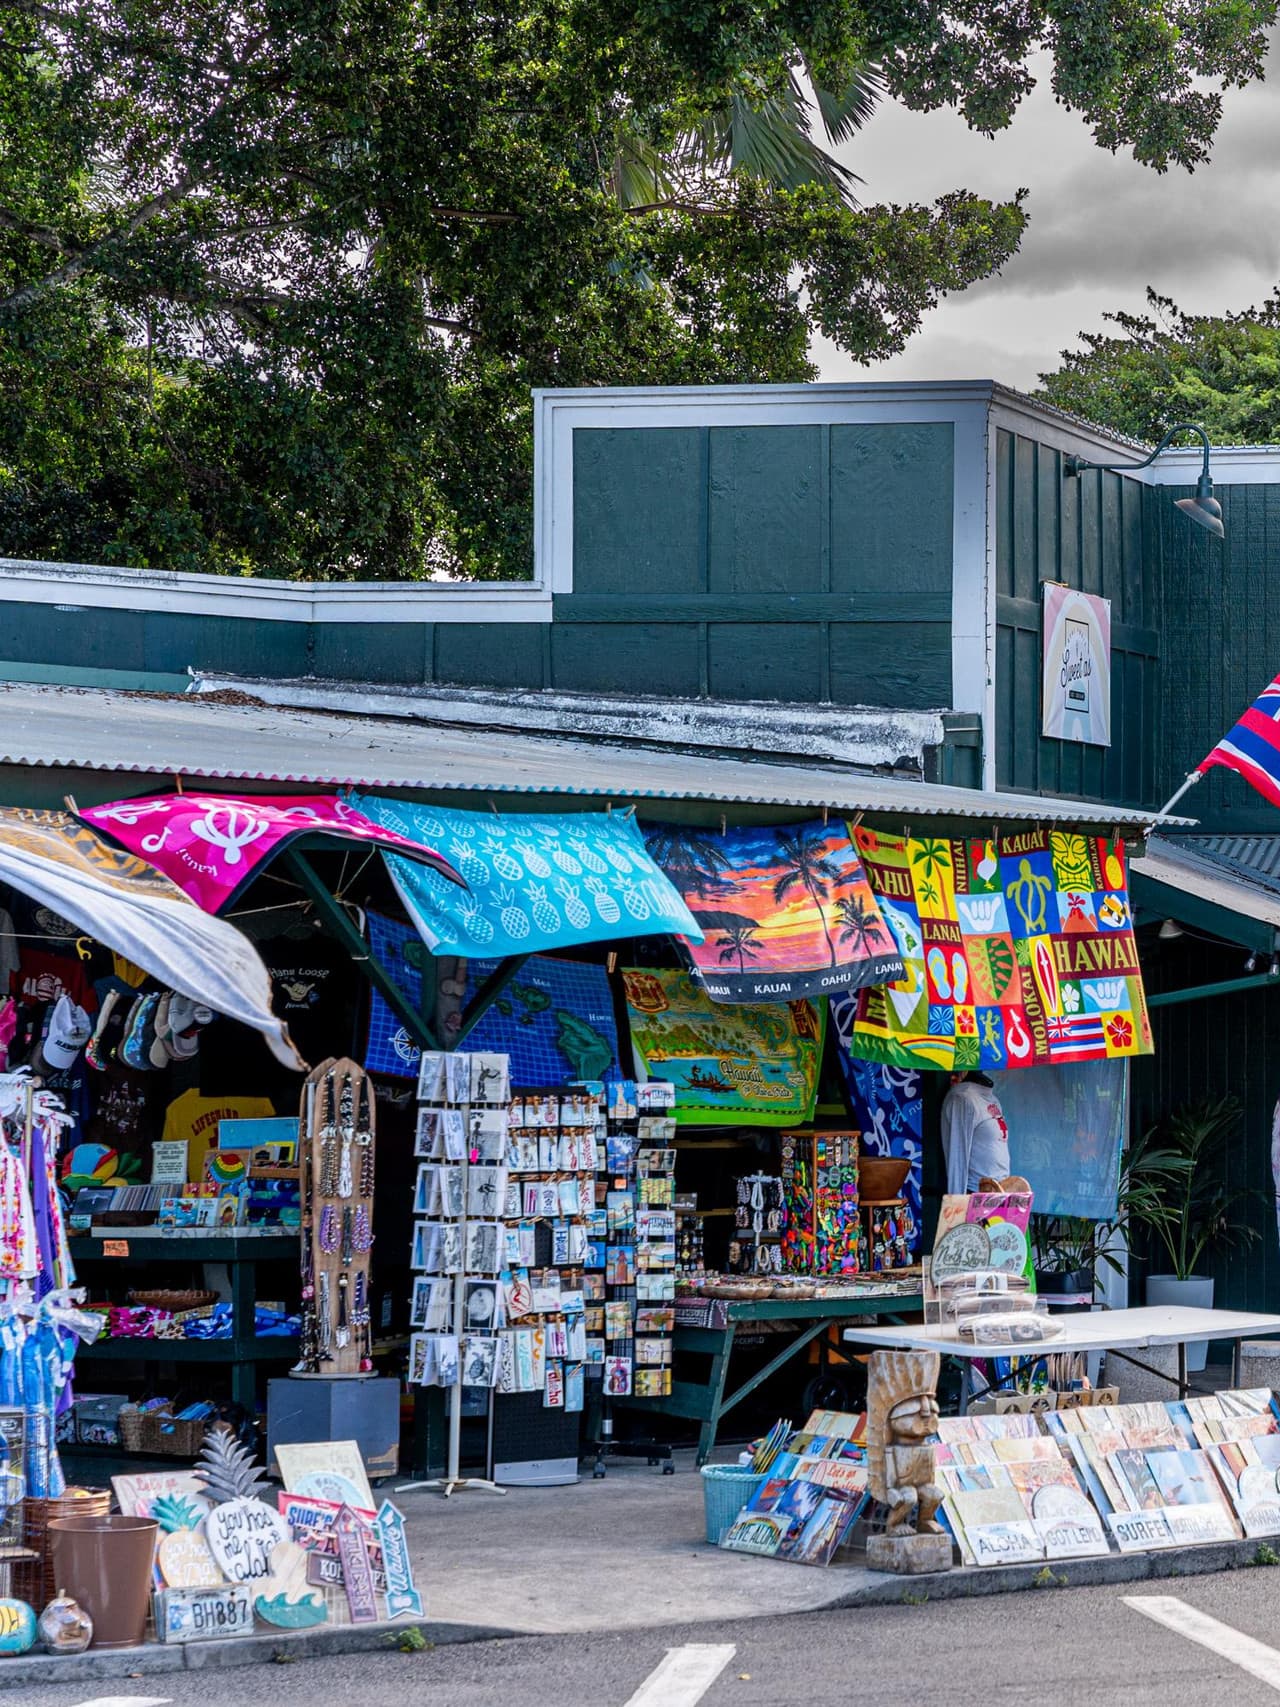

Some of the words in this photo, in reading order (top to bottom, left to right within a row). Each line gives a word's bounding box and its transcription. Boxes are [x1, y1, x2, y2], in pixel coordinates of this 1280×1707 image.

[1002, 829, 1045, 854] KAUAI
[922, 923, 961, 942] LANAI
[706, 985, 730, 996] MAUI
[754, 982, 792, 995] KAUAI
[820, 973, 852, 987] OAHU
[874, 962, 904, 975] LANAI
[1021, 971, 1049, 1056] MOLOKAI
[979, 1533, 1031, 1555] ALOHA
